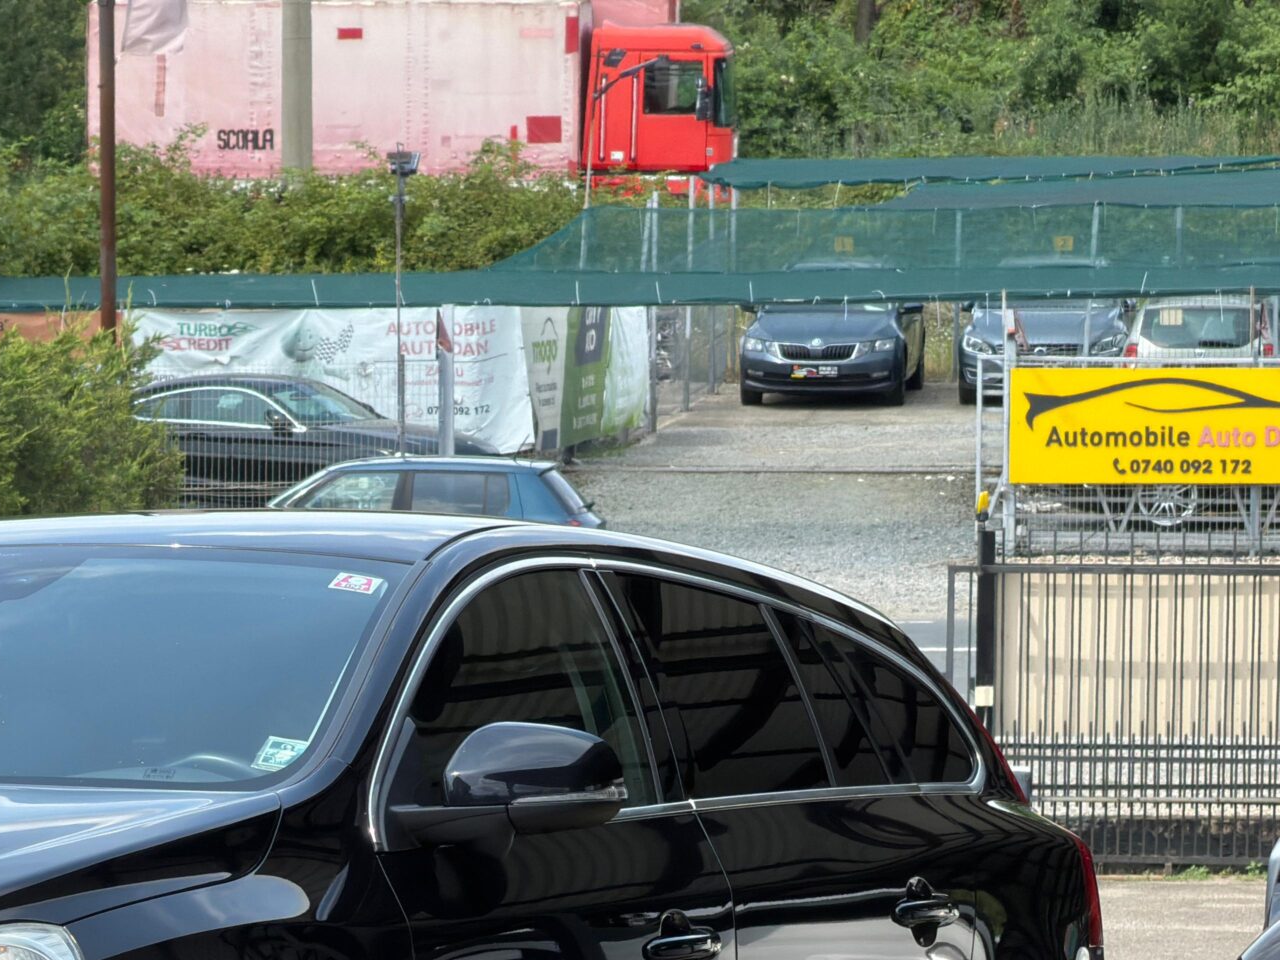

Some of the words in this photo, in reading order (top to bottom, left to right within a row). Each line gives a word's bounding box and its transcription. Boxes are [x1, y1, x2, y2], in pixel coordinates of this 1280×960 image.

[176, 321, 233, 337] TURBO
[386, 319, 497, 336] AUTOOBILE
[474, 404, 490, 415] 172
[1045, 425, 1191, 447] Automobile
[1197, 425, 1257, 447] Auto
[1129, 458, 1174, 474] 0740
[1179, 458, 1213, 474] 092
[1219, 458, 1252, 474] 172
